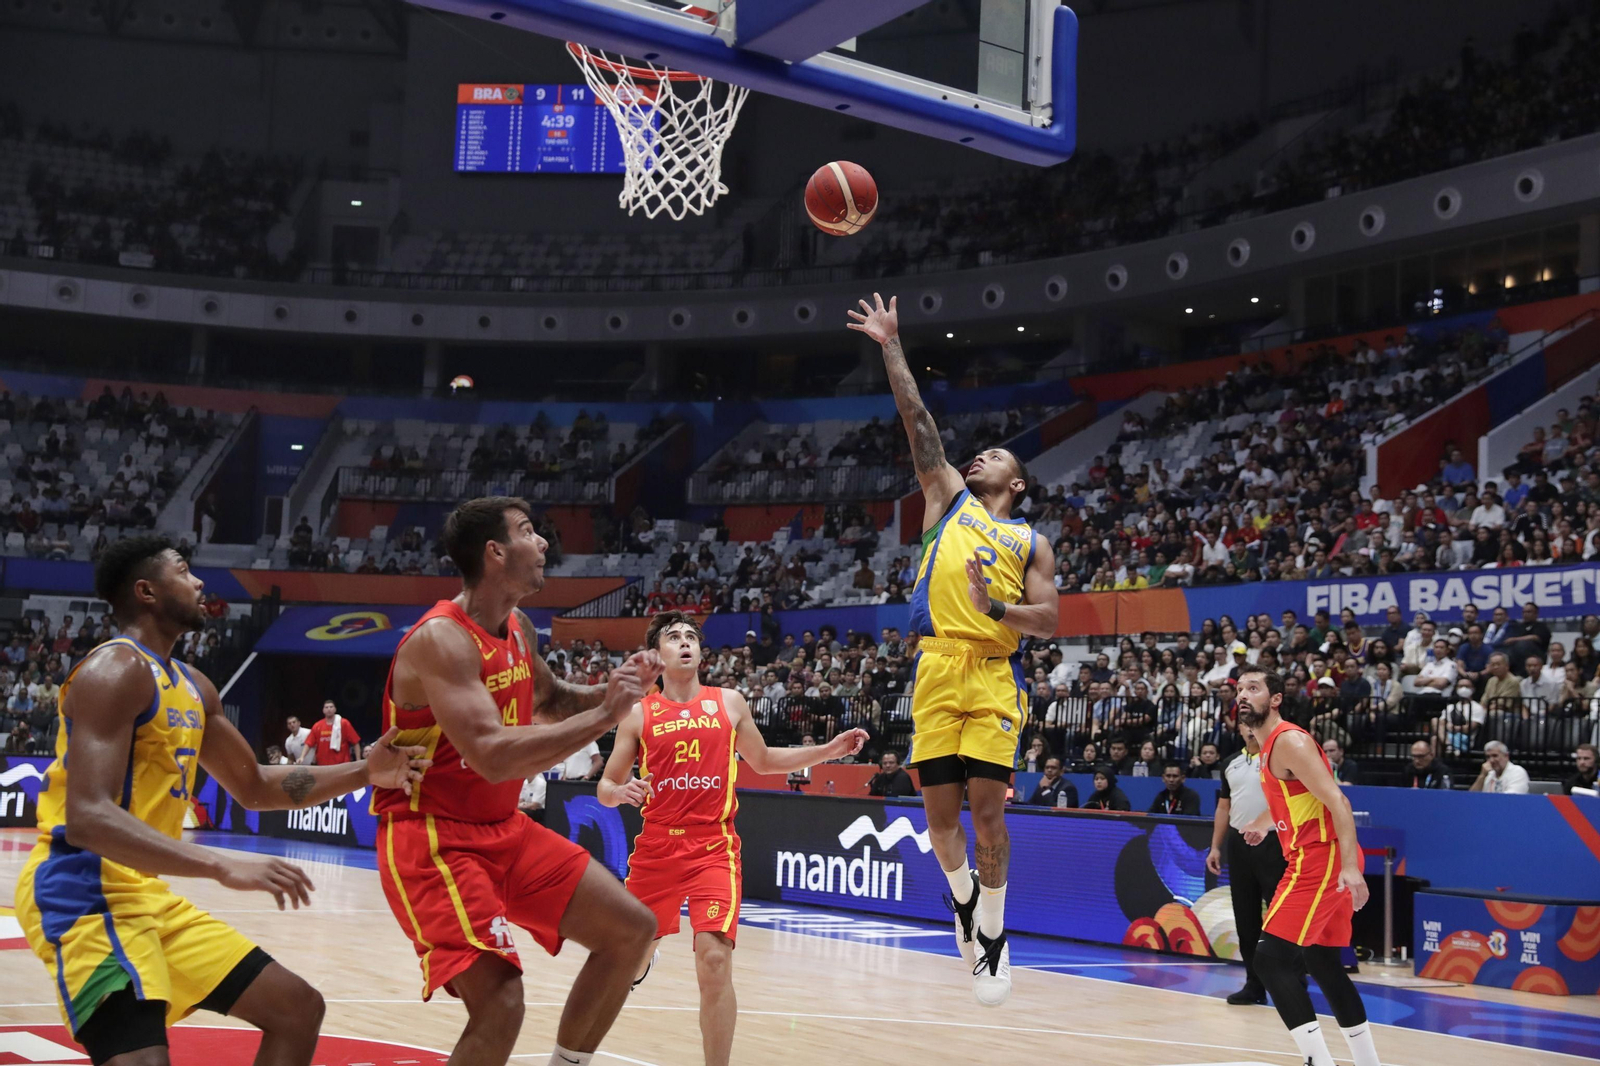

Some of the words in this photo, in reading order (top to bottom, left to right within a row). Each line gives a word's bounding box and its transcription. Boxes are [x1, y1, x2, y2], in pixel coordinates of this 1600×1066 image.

[473, 88, 503, 100] BRA
[536, 88, 546, 100] 9
[571, 88, 585, 100] 11
[541, 115, 575, 128] 4:39
[957, 512, 1024, 562] BRASIL
[1307, 582, 1399, 617] FIBA
[486, 659, 532, 693] ESPAÑA
[166, 708, 203, 730] BRASIL
[652, 715, 721, 737] ESPAÑA
[674, 739, 701, 764] 24
[657, 772, 721, 792] endesa
[287, 798, 348, 836] mandiri
[776, 845, 904, 901] mandiri
[1423, 920, 1442, 932] WIN
[1423, 940, 1441, 953] ALL
[1520, 931, 1541, 943] WIN
[1520, 953, 1541, 965] ALL
